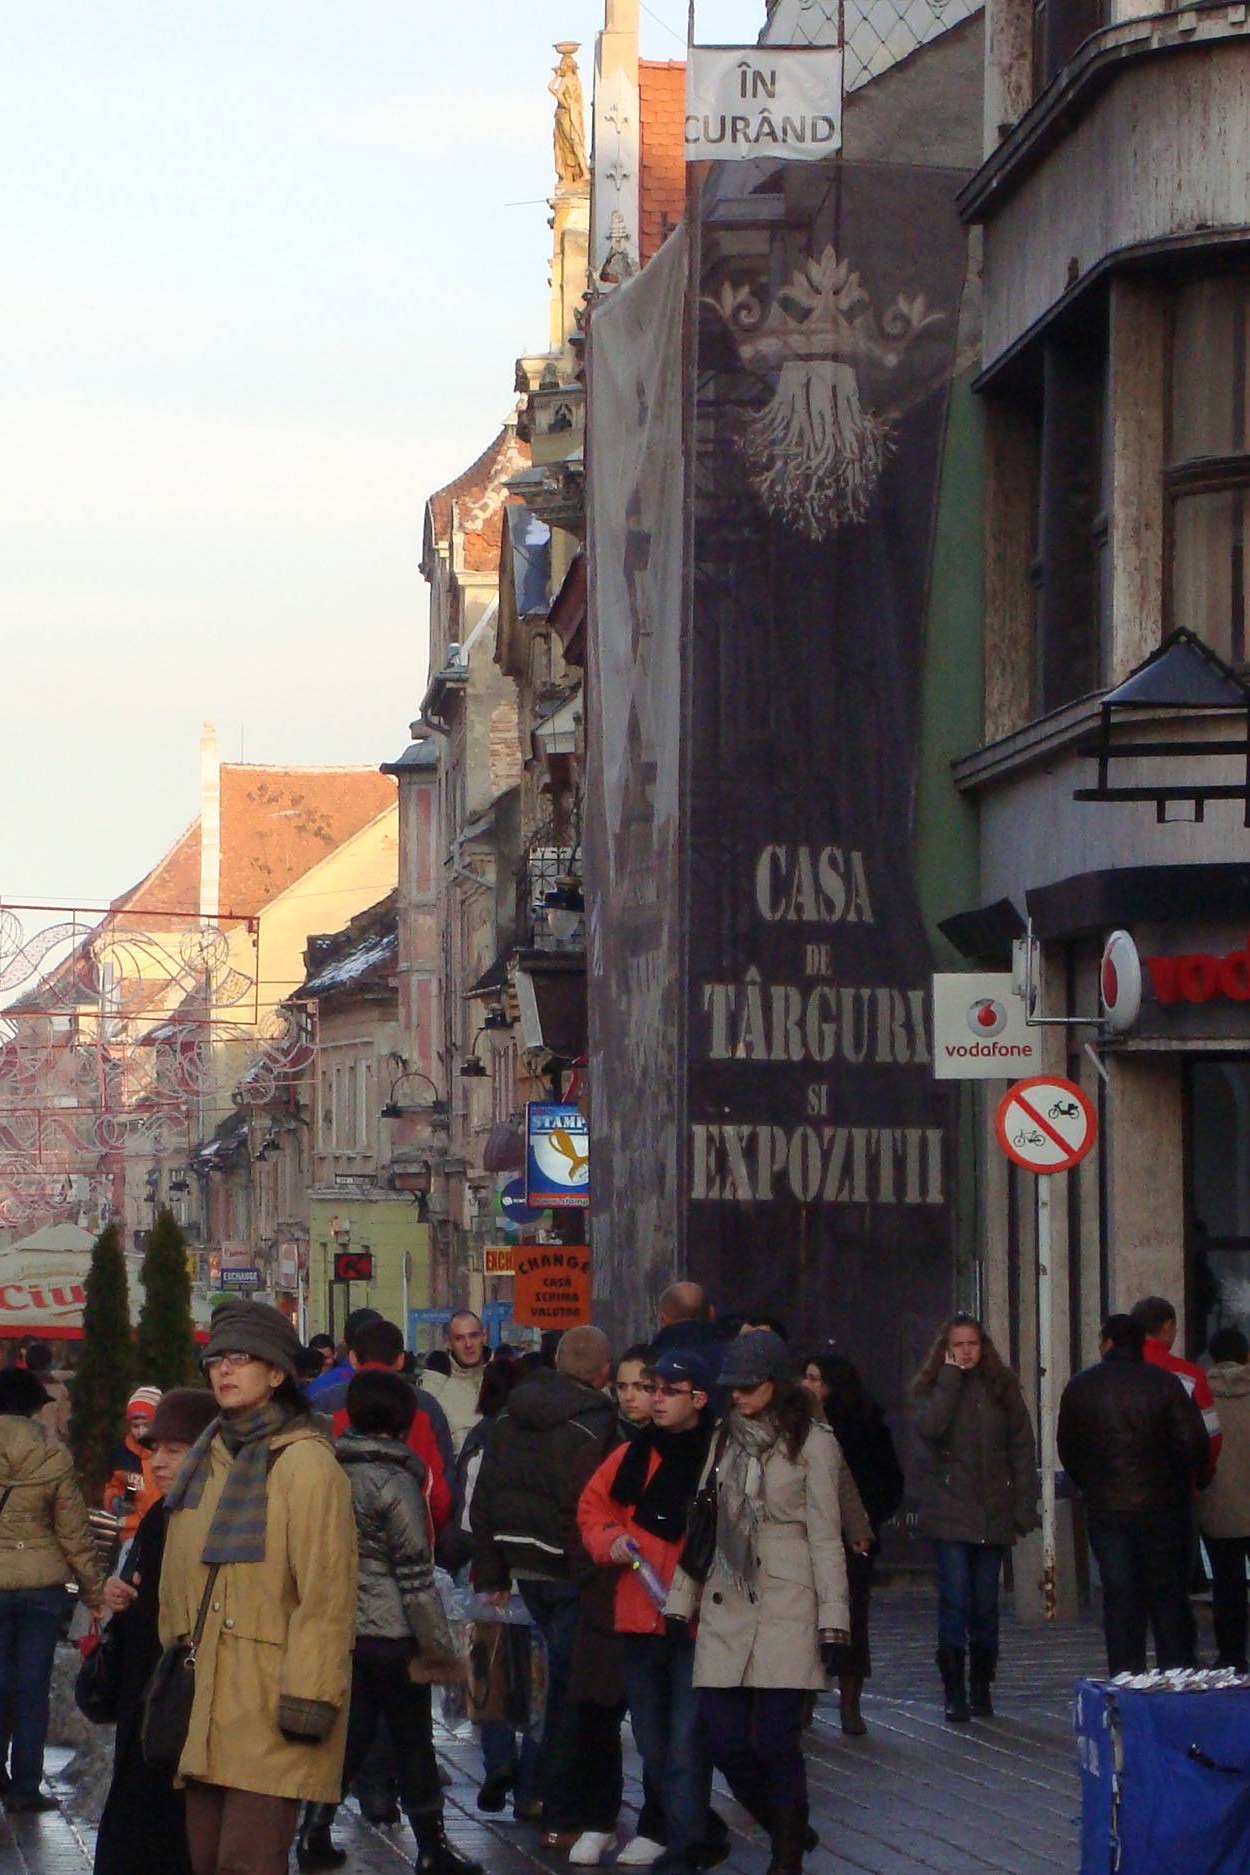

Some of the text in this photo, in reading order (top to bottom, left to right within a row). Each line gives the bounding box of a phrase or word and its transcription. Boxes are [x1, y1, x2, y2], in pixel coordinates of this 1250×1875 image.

[737, 61, 776, 98] ÎN
[685, 108, 835, 143] CURÂND
[756, 845, 874, 923] CASA
[806, 944, 832, 976] DE
[945, 1042, 1032, 1057] vodafone
[808, 1085, 828, 1115] SI
[691, 1125, 944, 1202] EXPOZITII
[223, 1271, 258, 1281] EXCHANGE
